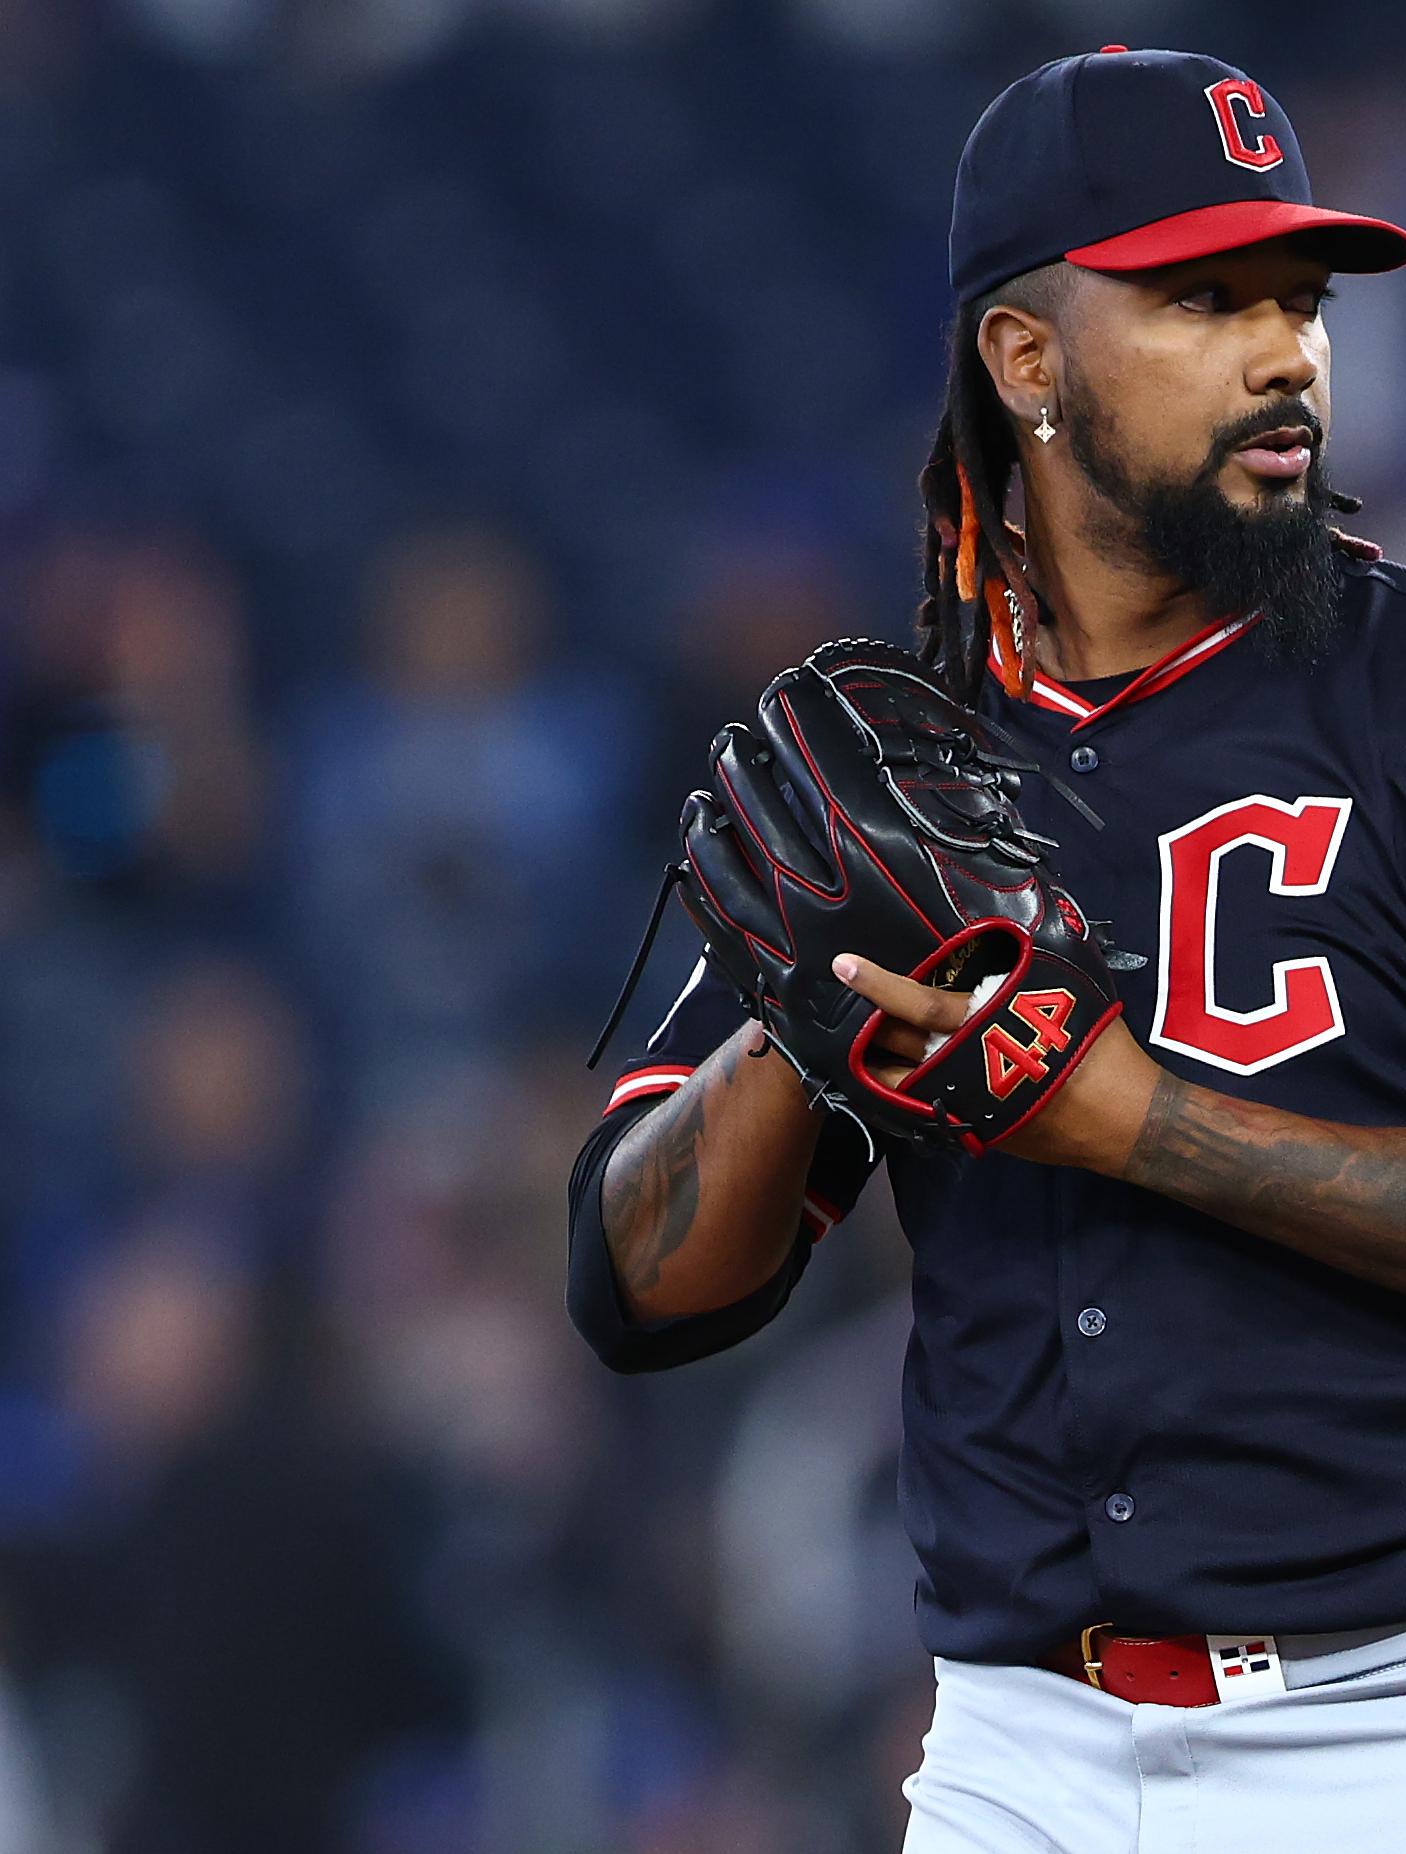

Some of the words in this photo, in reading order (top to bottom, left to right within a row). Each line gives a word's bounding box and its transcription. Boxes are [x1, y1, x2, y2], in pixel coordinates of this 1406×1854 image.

[1204, 78, 1284, 173] C
[1149, 794, 1353, 1076] C
[981, 987, 1077, 1101] 44
